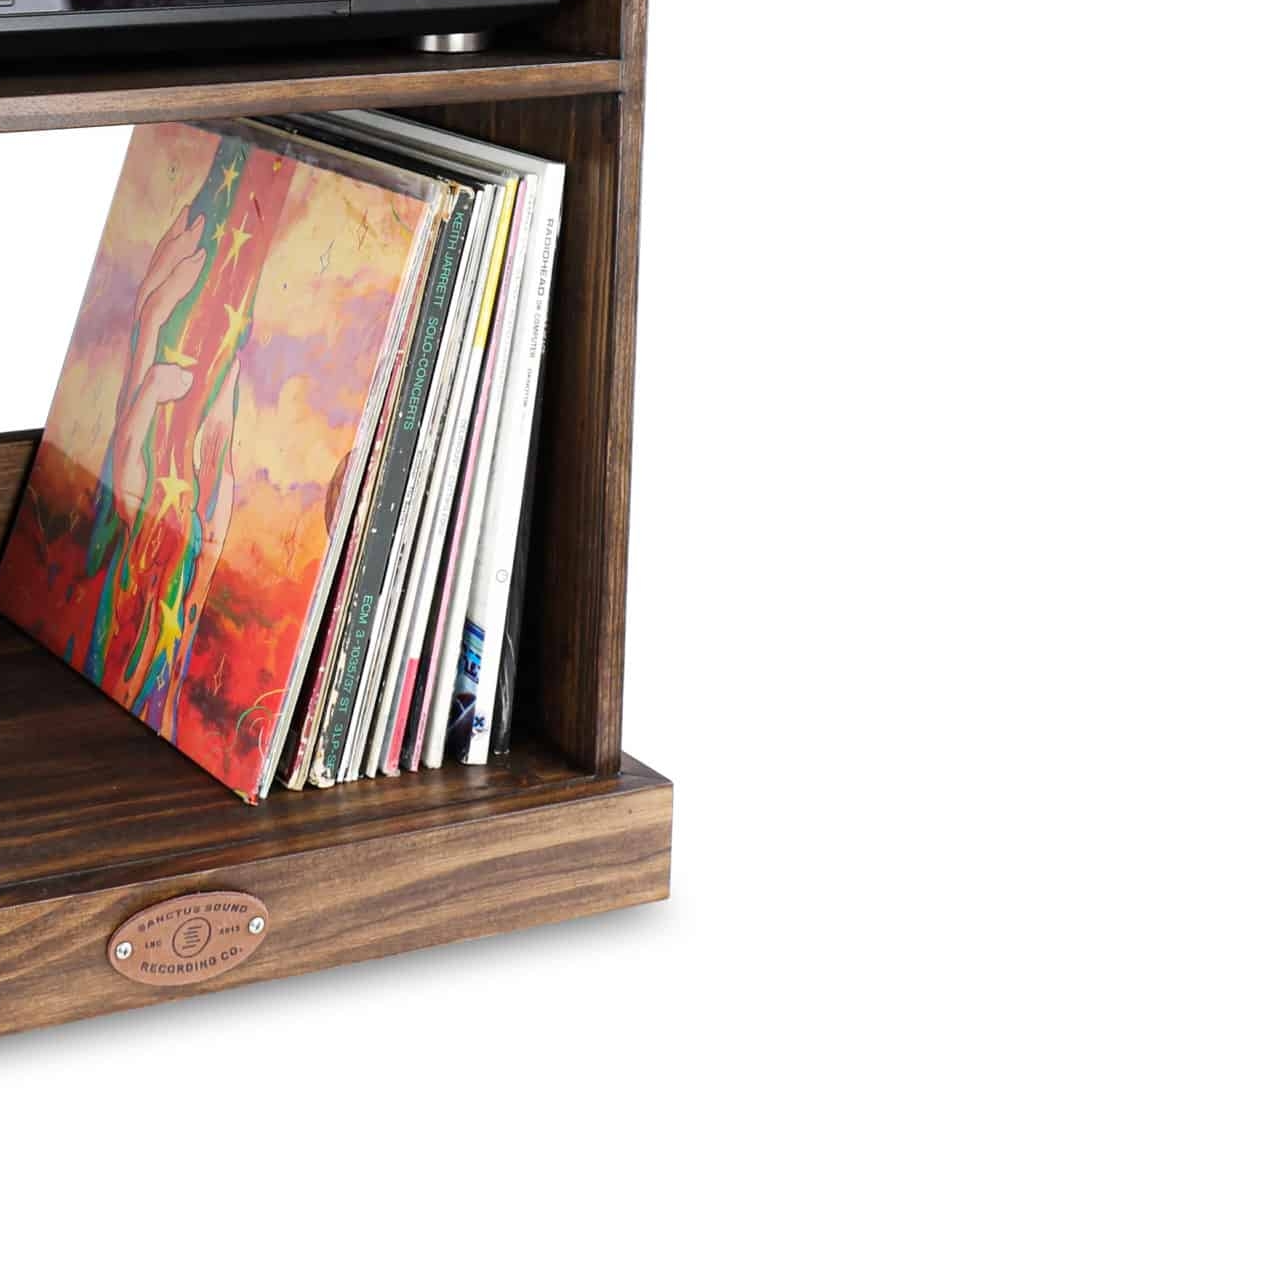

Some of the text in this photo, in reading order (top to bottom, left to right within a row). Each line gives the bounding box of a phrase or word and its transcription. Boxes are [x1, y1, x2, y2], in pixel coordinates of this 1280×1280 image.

[447, 211, 465, 251] KEITH
[537, 218, 555, 296] RADIOHEAD
[431, 250, 454, 307] JARRETT
[529, 312, 542, 359] COMPUTER
[403, 317, 440, 431] SOLO-CONCERTS
[359, 594, 374, 625] ECM
[338, 698, 351, 712] ST
[137, 902, 249, 933] SANCTUS SOUND
[140, 945, 243, 975] RECORDING CO.
